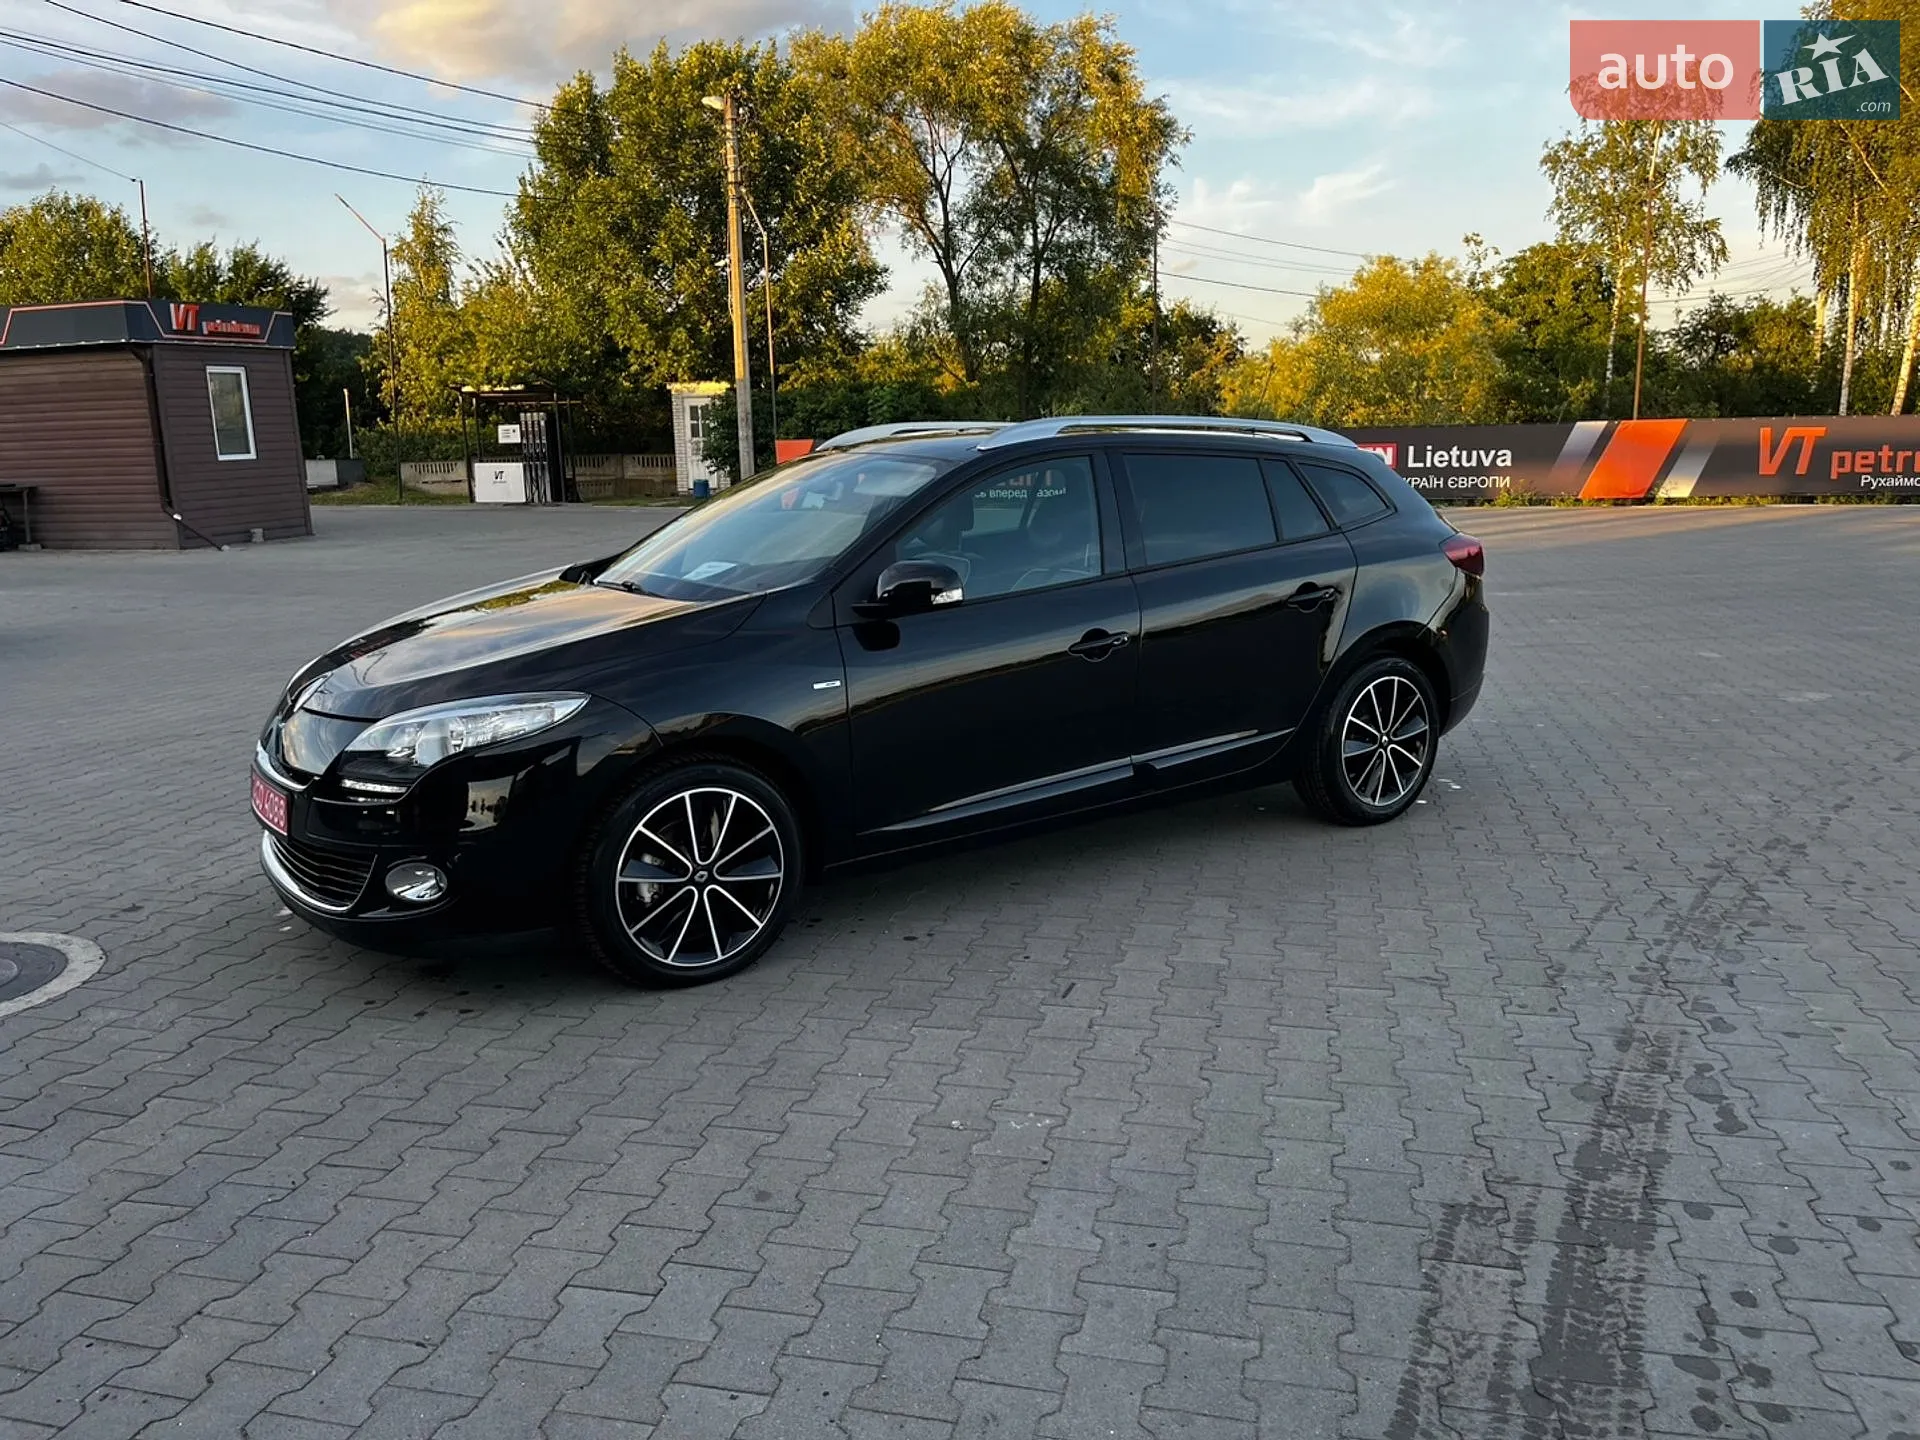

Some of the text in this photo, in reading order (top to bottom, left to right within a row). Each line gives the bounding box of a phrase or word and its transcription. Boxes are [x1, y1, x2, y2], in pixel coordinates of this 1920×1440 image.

[169, 303, 200, 332] VT
[1407, 445, 1513, 468] Lietuva
[1758, 426, 1827, 476] VT
[494, 470, 505, 480] VT
[1447, 475, 1511, 489] ЄВРОПИ
